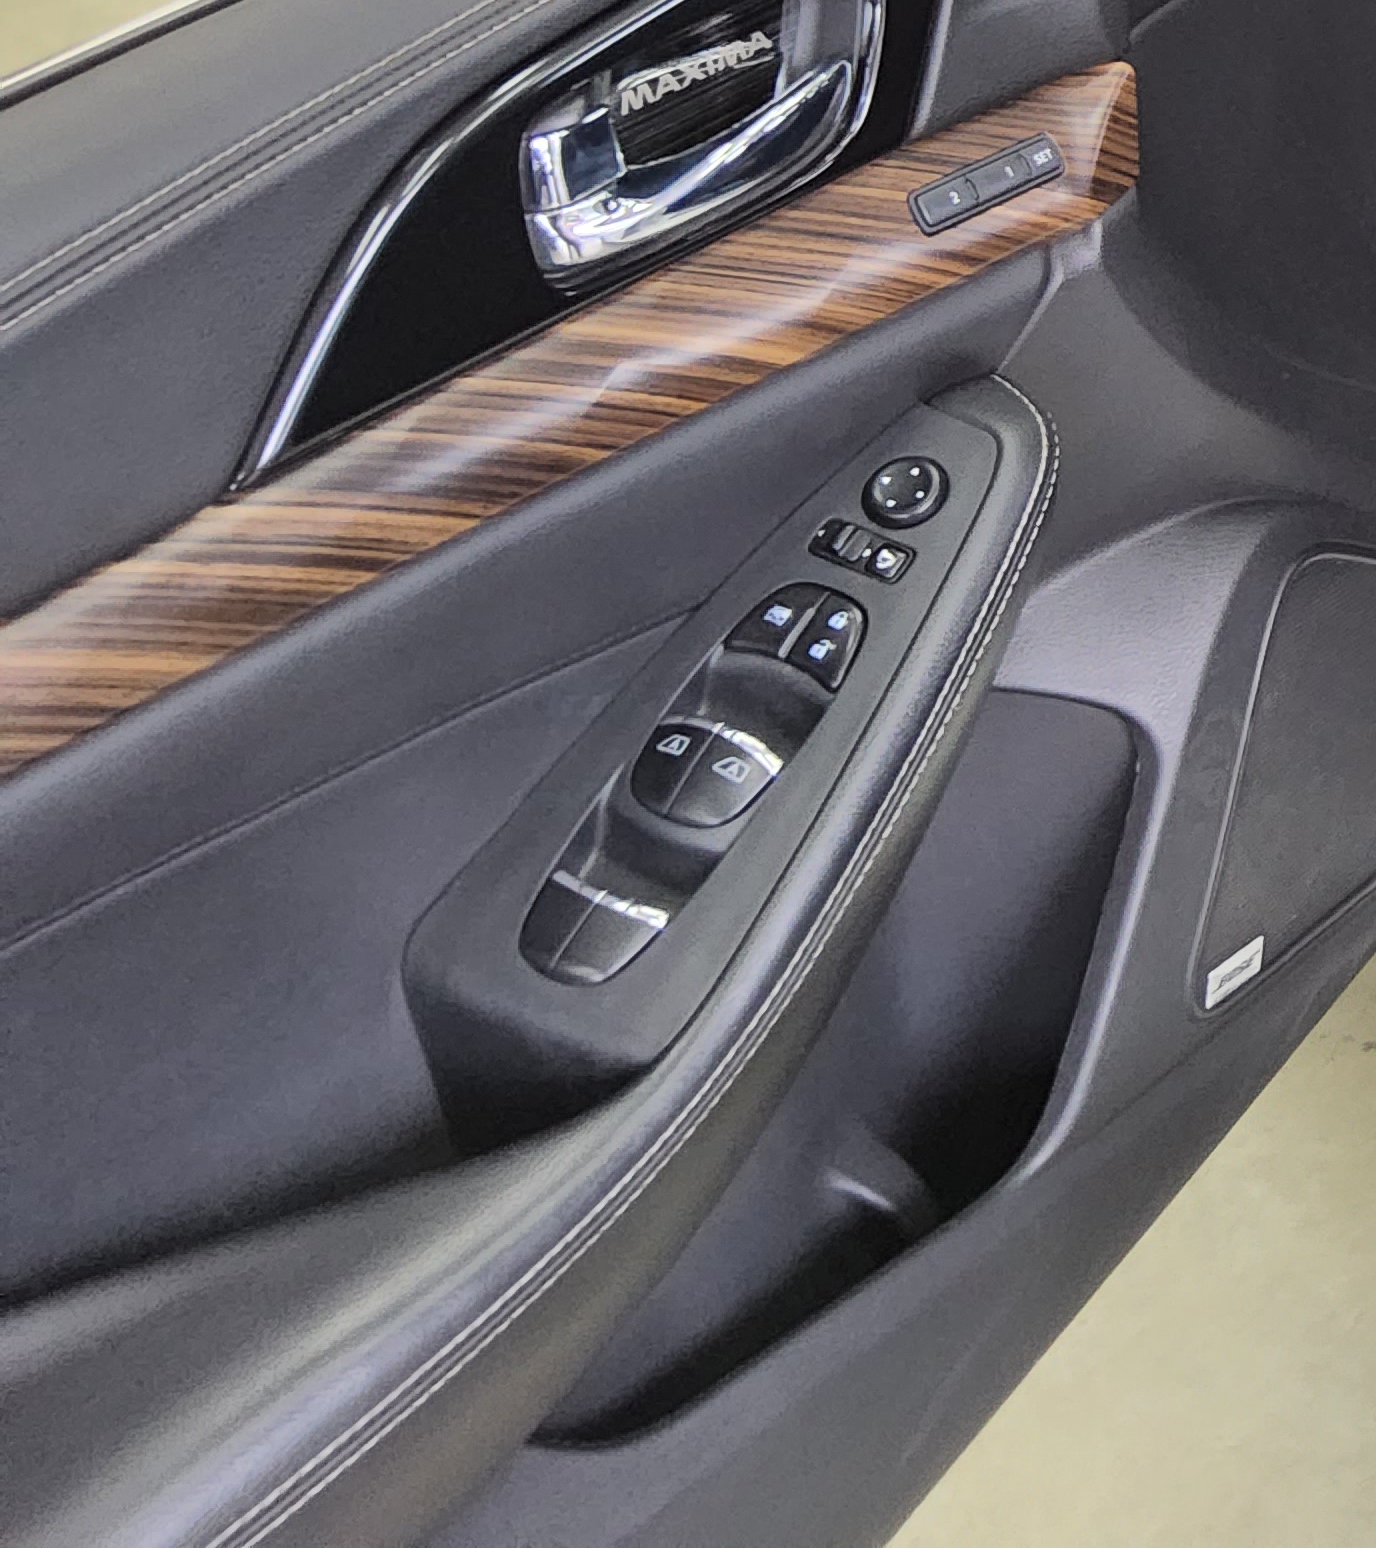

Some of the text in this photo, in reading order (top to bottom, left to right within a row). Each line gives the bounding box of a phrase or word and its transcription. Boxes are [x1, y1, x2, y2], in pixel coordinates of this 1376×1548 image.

[621, 30, 773, 117] MAXIMA
[1033, 148, 1053, 166] SET
[1004, 166, 1015, 178] 1
[949, 191, 960, 204] 2
